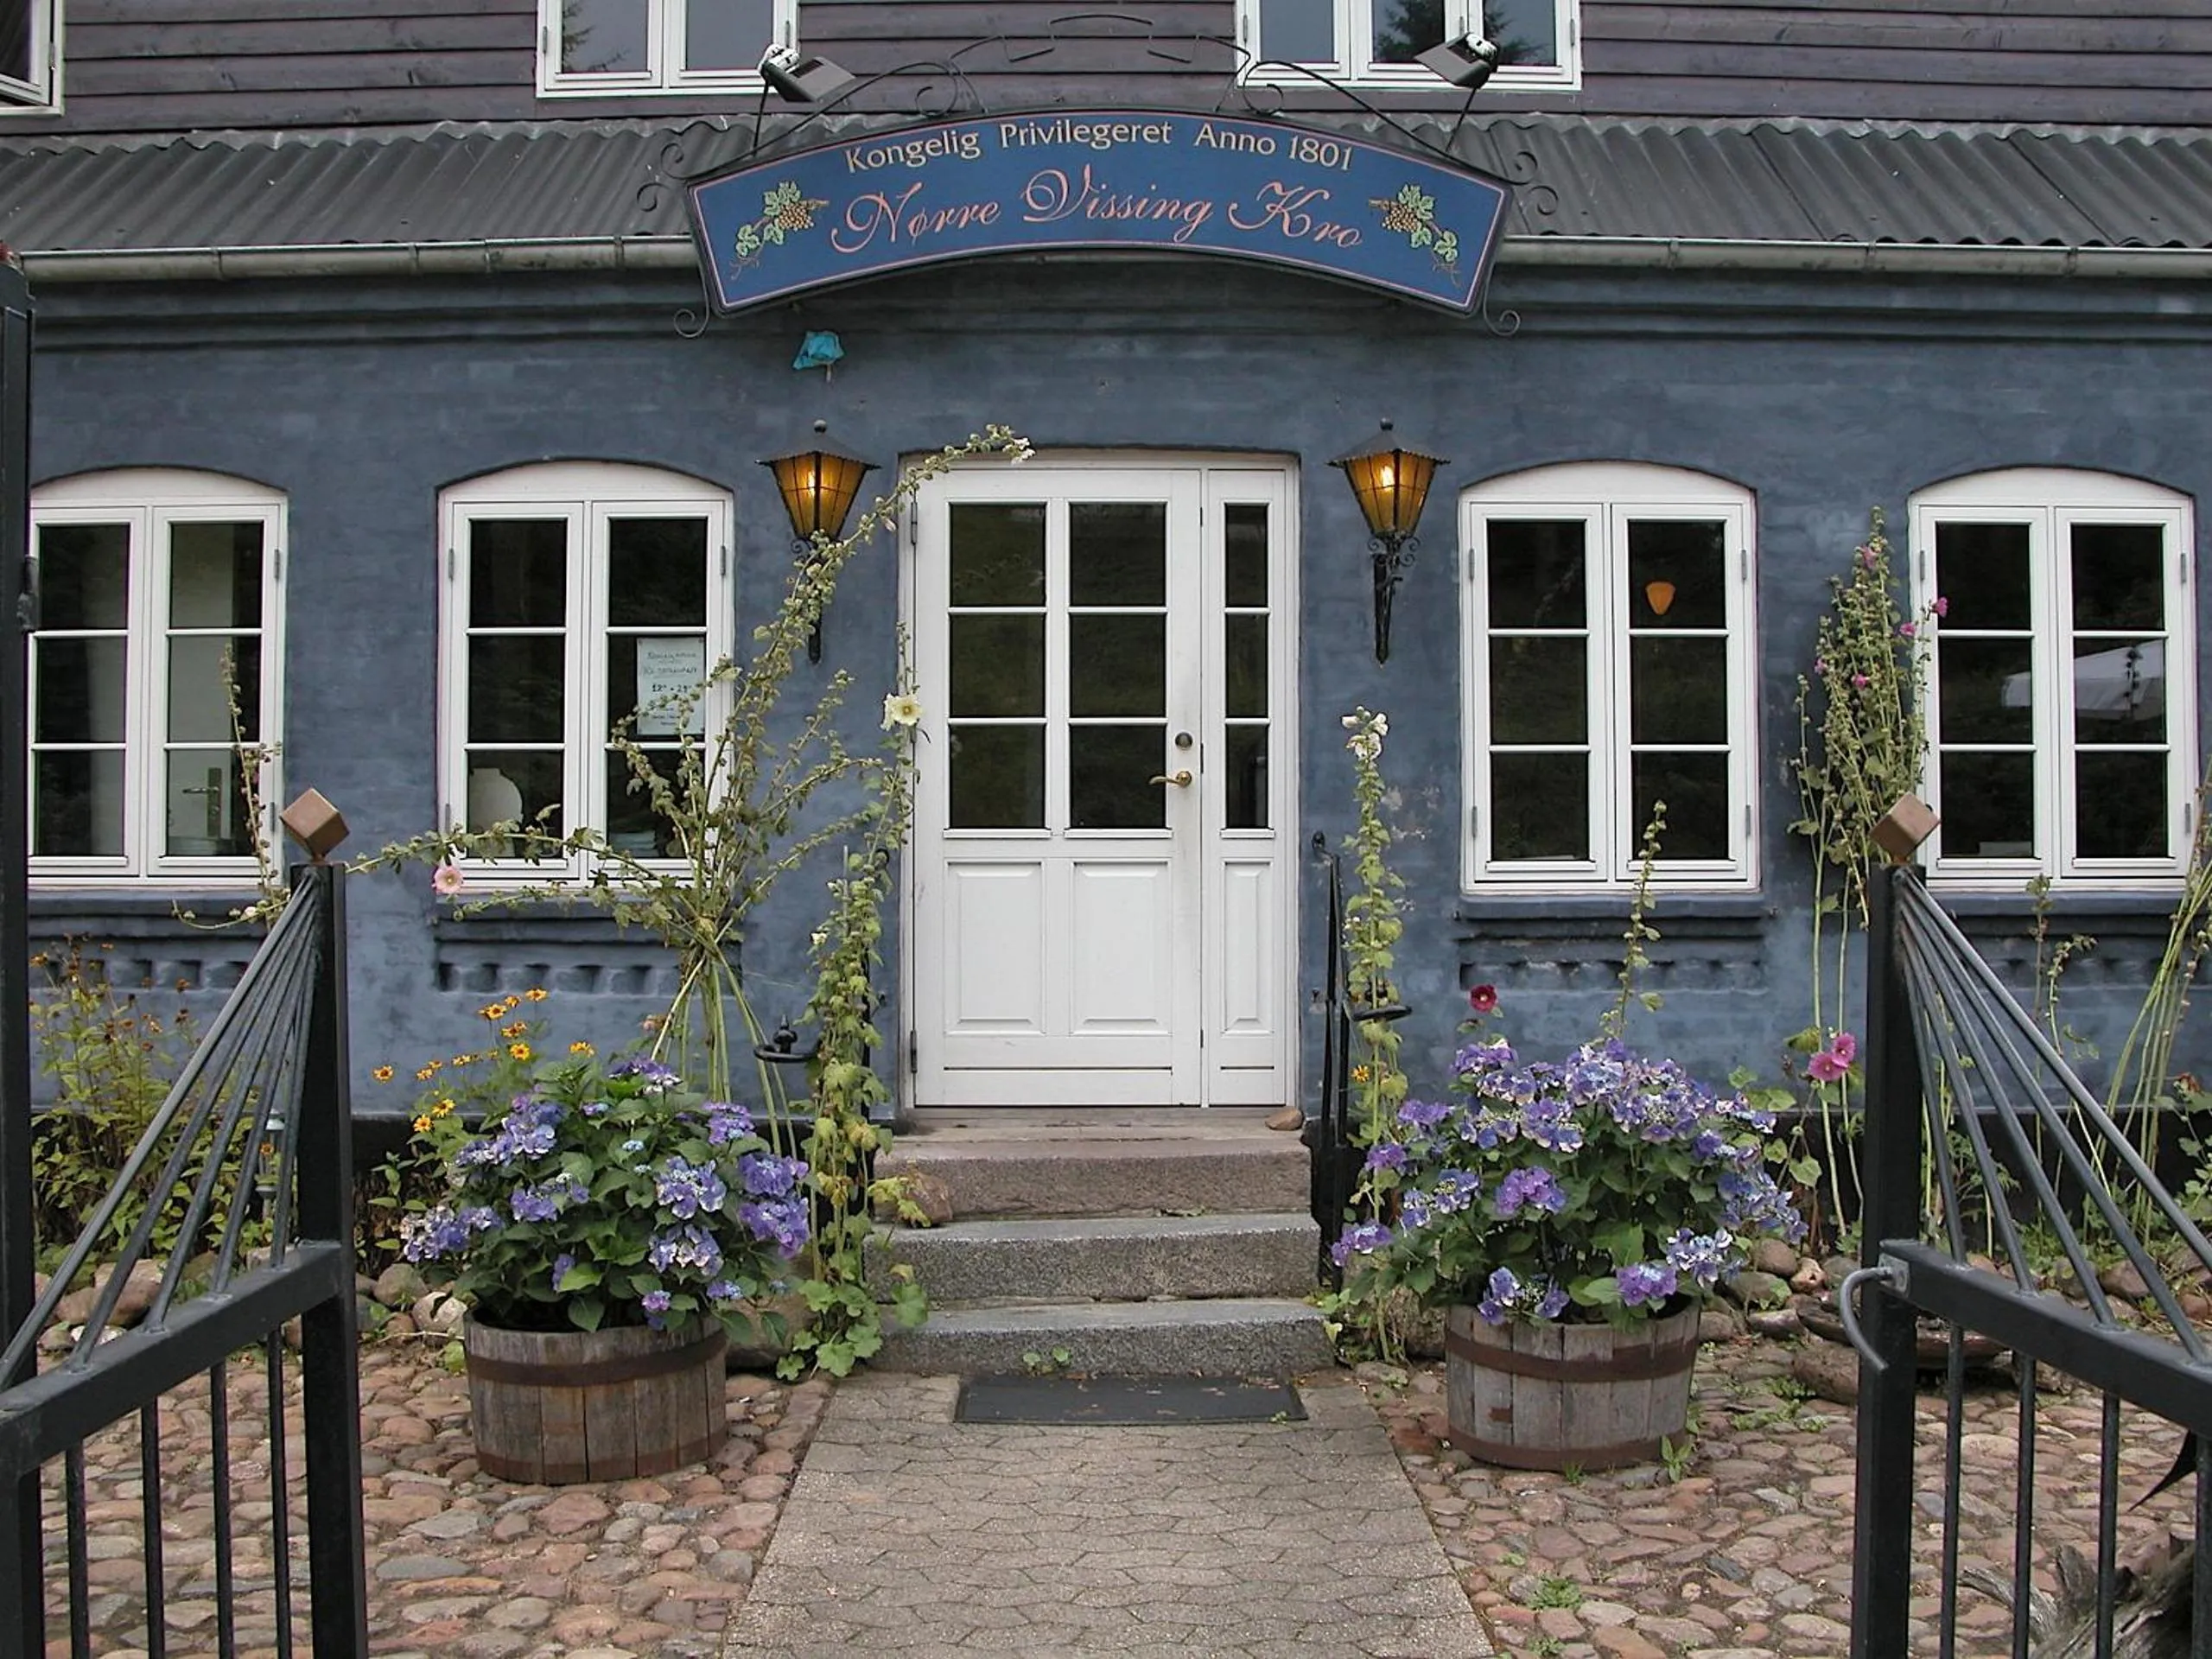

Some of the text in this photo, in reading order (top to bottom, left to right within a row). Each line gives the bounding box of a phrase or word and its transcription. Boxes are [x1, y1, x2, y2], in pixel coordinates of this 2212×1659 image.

[845, 118, 1352, 173] Kongelig Privilegeret Anno 1801
[831, 162, 1363, 253] Nørre Vissing Kro
